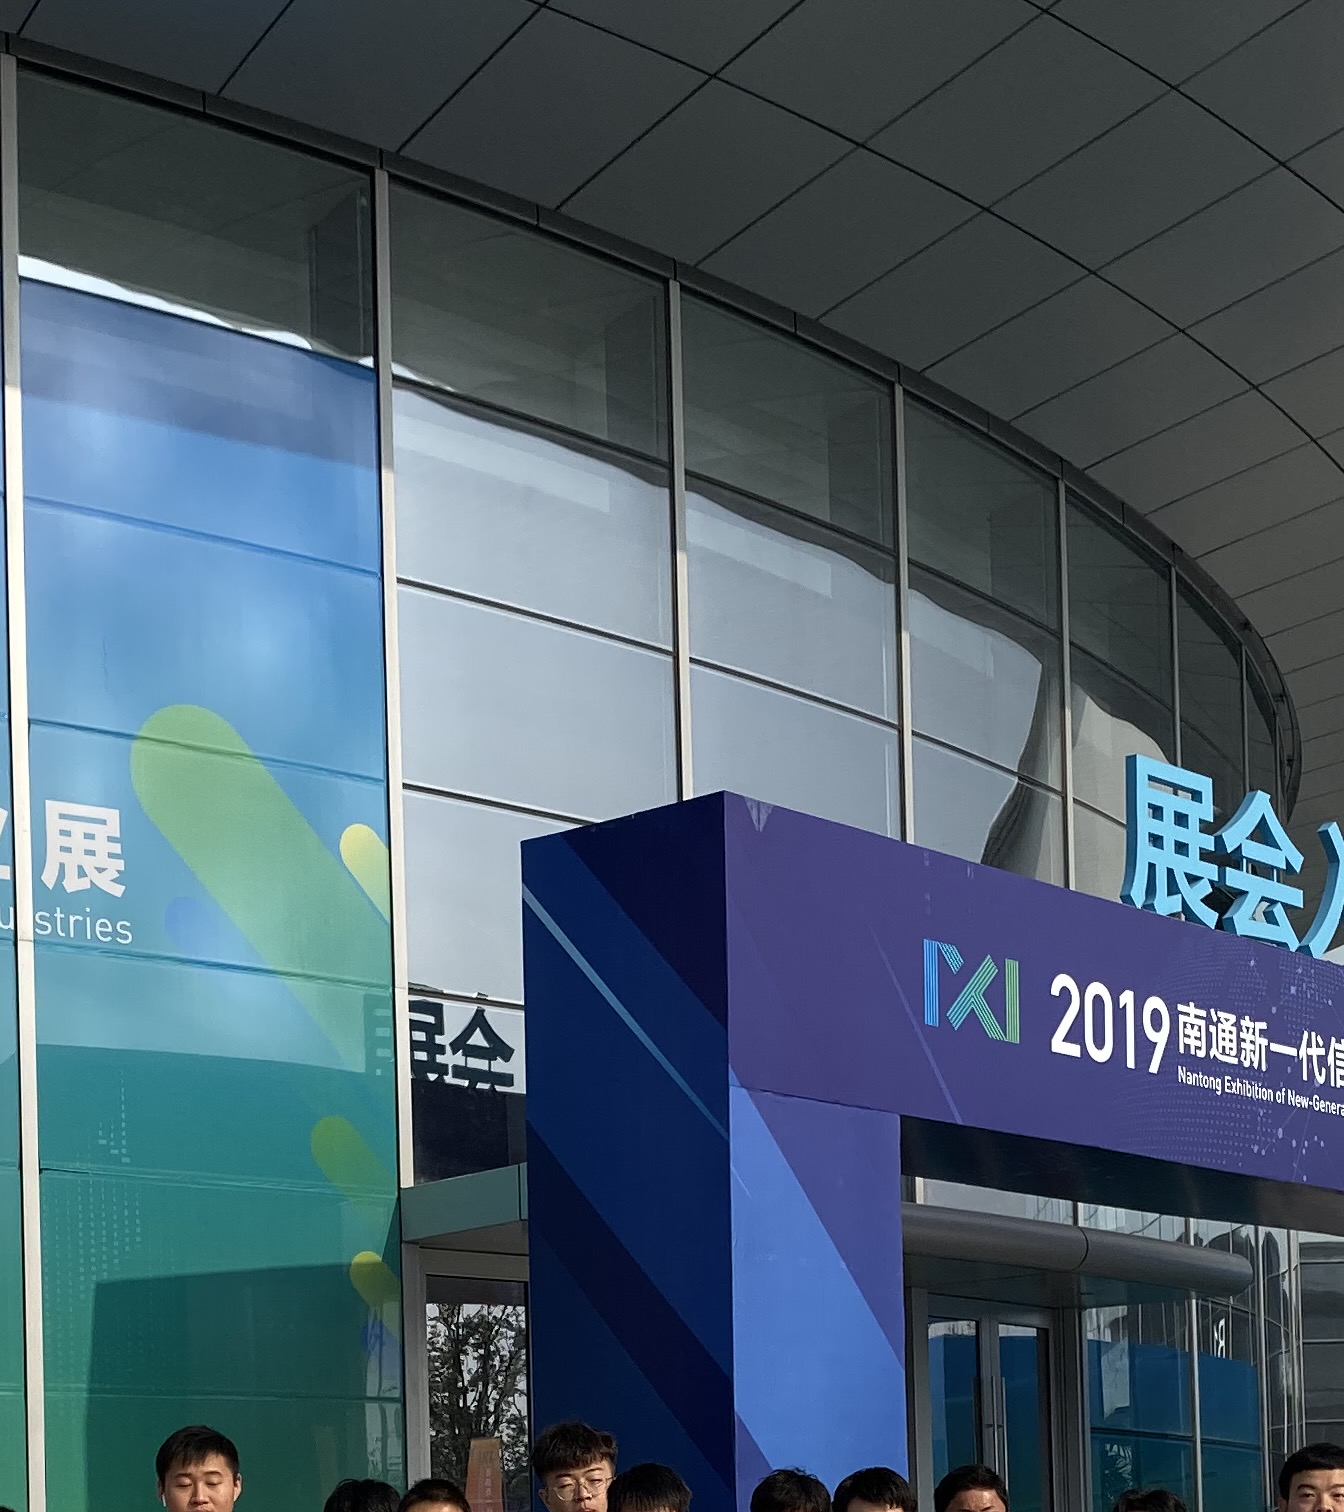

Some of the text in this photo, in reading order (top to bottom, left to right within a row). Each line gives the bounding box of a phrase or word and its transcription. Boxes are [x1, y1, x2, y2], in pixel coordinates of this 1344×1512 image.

[1050, 974, 1171, 1074] 2019
[1178, 1065, 1222, 1095] Nantong
[1225, 1076, 1274, 1103] Exhibition
[1276, 1087, 1286, 1105] of
